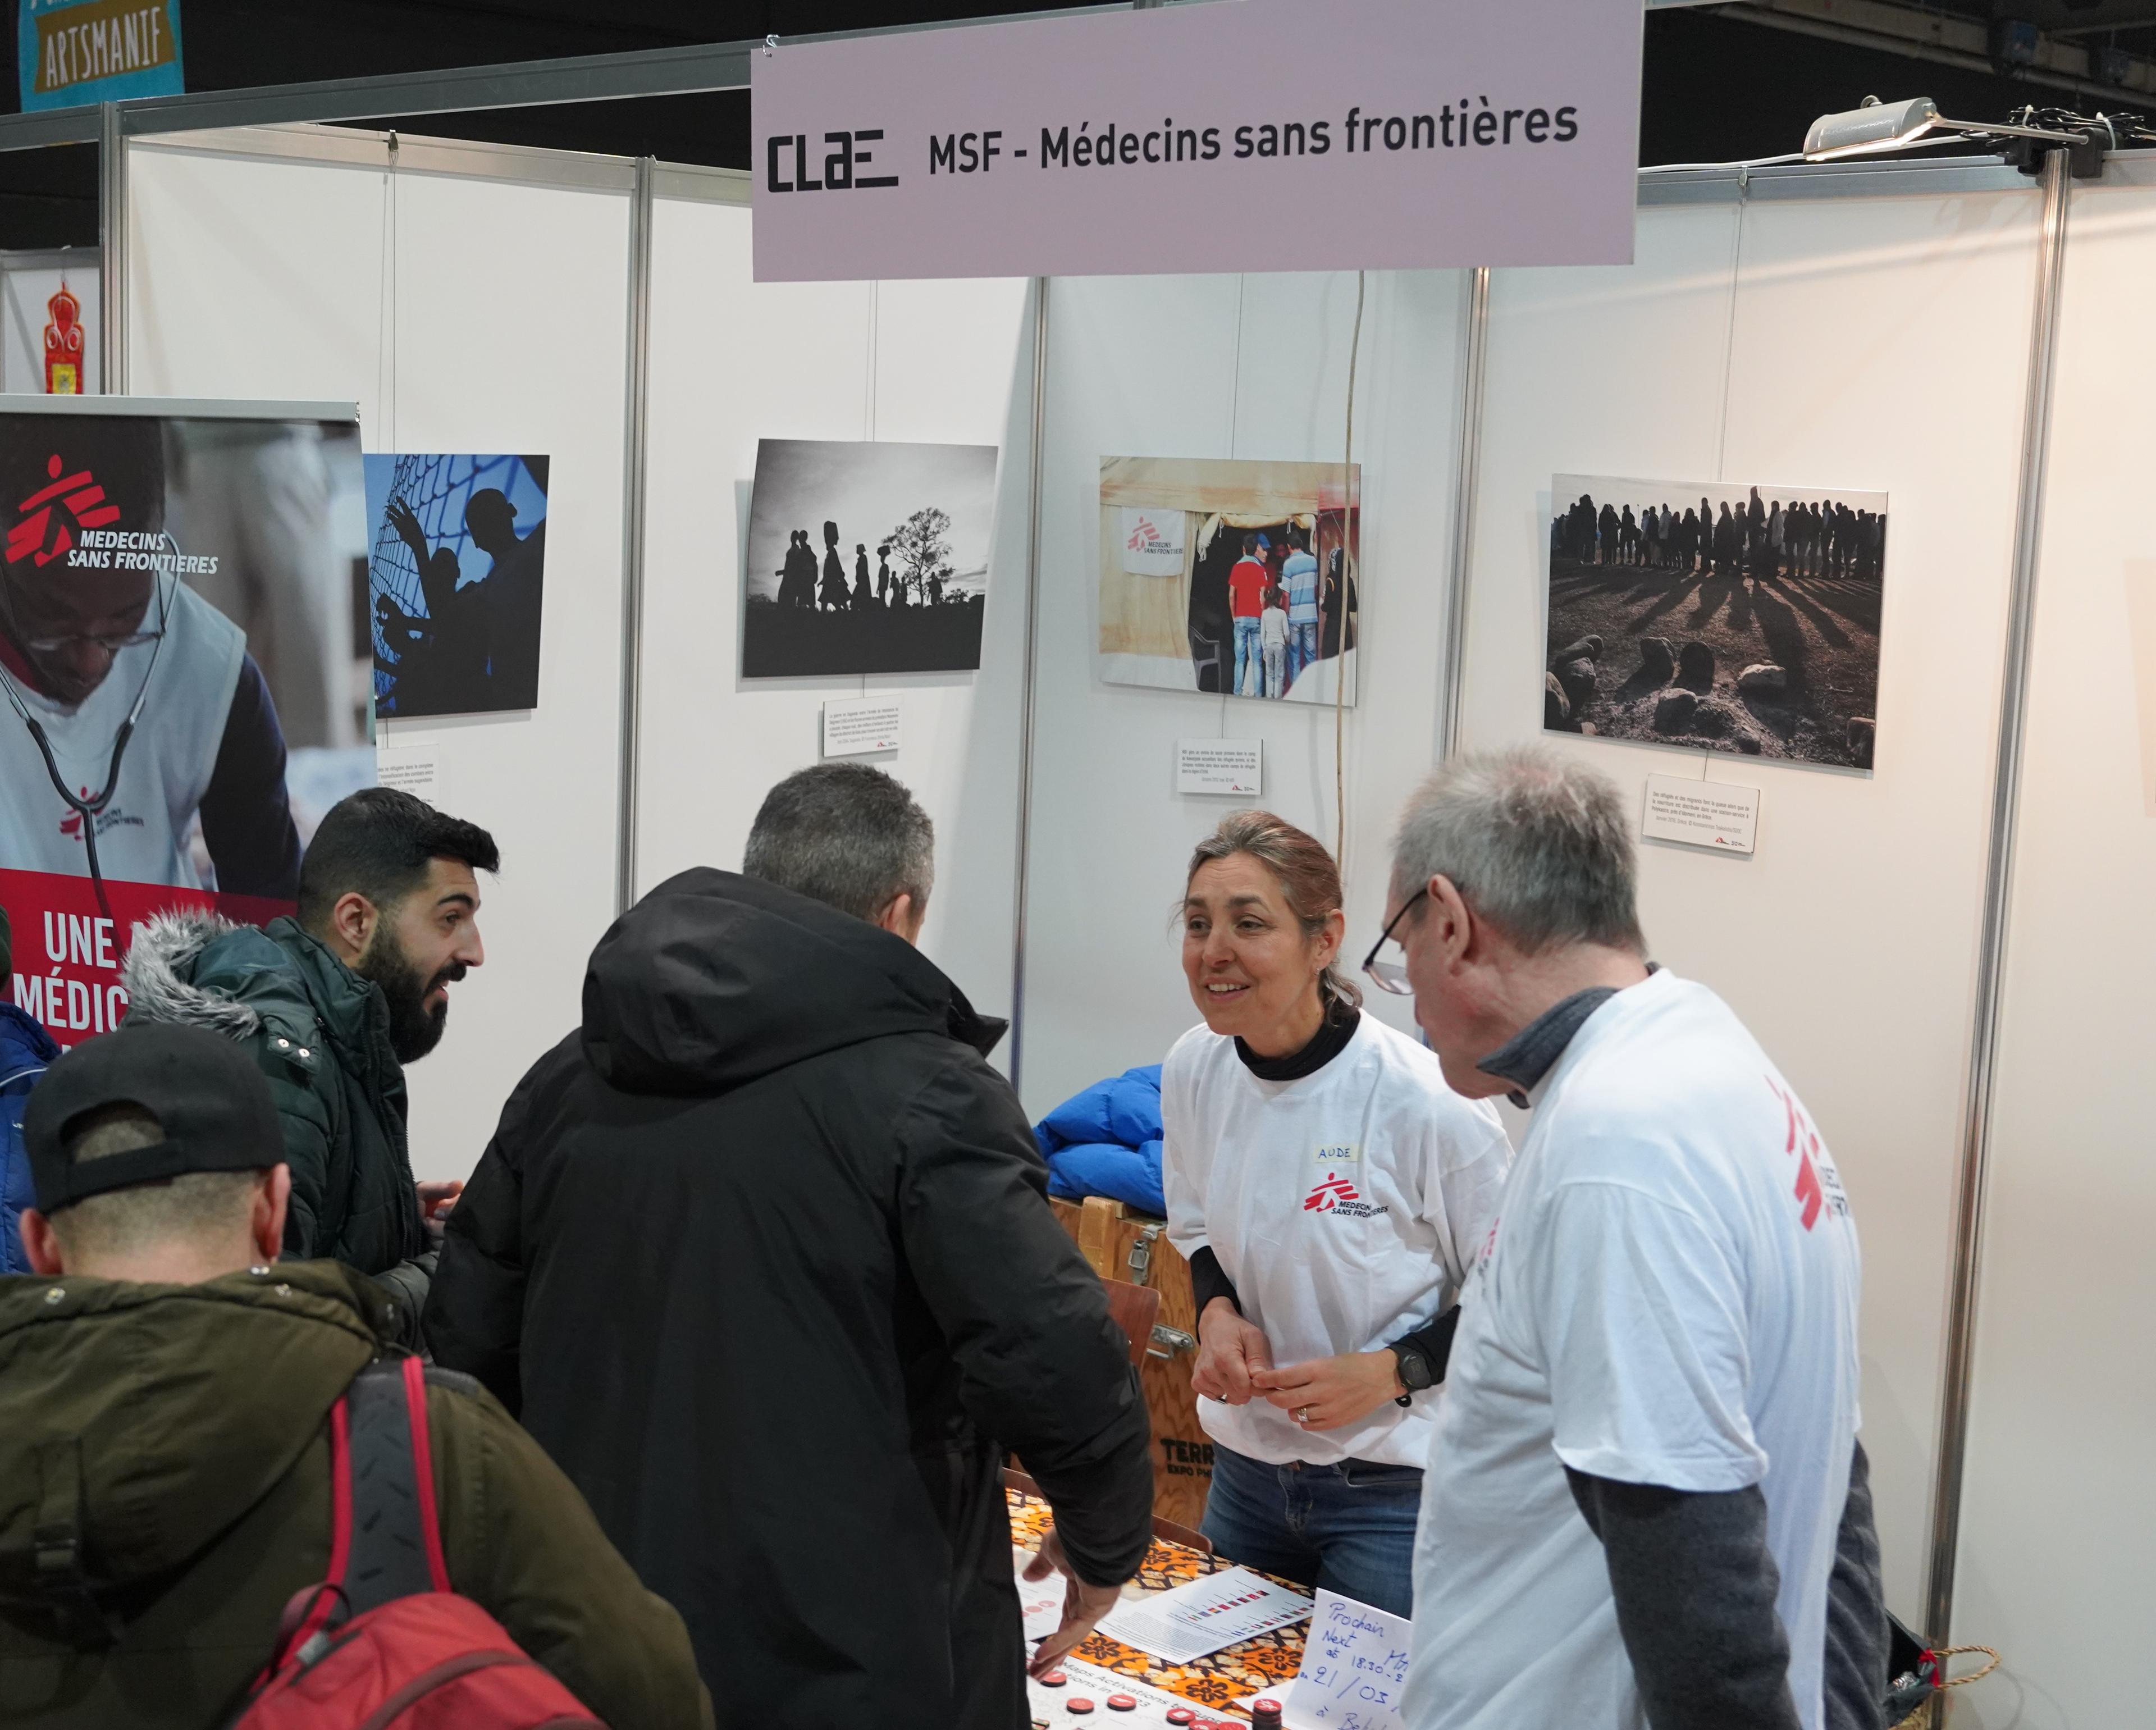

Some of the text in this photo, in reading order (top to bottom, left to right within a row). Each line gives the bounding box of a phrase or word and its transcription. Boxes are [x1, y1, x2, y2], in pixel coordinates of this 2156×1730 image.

[45, 6, 160, 88] ARTSMANIF
[930, 95, 1578, 175] MSF - Médecins sans frontières
[80, 530, 166, 551] MEDECINS
[67, 549, 219, 575] SANS FRONTIERES
[43, 911, 117, 969] UNE
[1318, 1147, 1351, 1159] AUDE
[1331, 1207, 1351, 1216] SANS
[1159, 1437, 1214, 1465] TERR
[1167, 1464, 1194, 1476] EXPO
[1328, 1602, 1385, 1638] Prochain
[1322, 1627, 1358, 1648] Next
